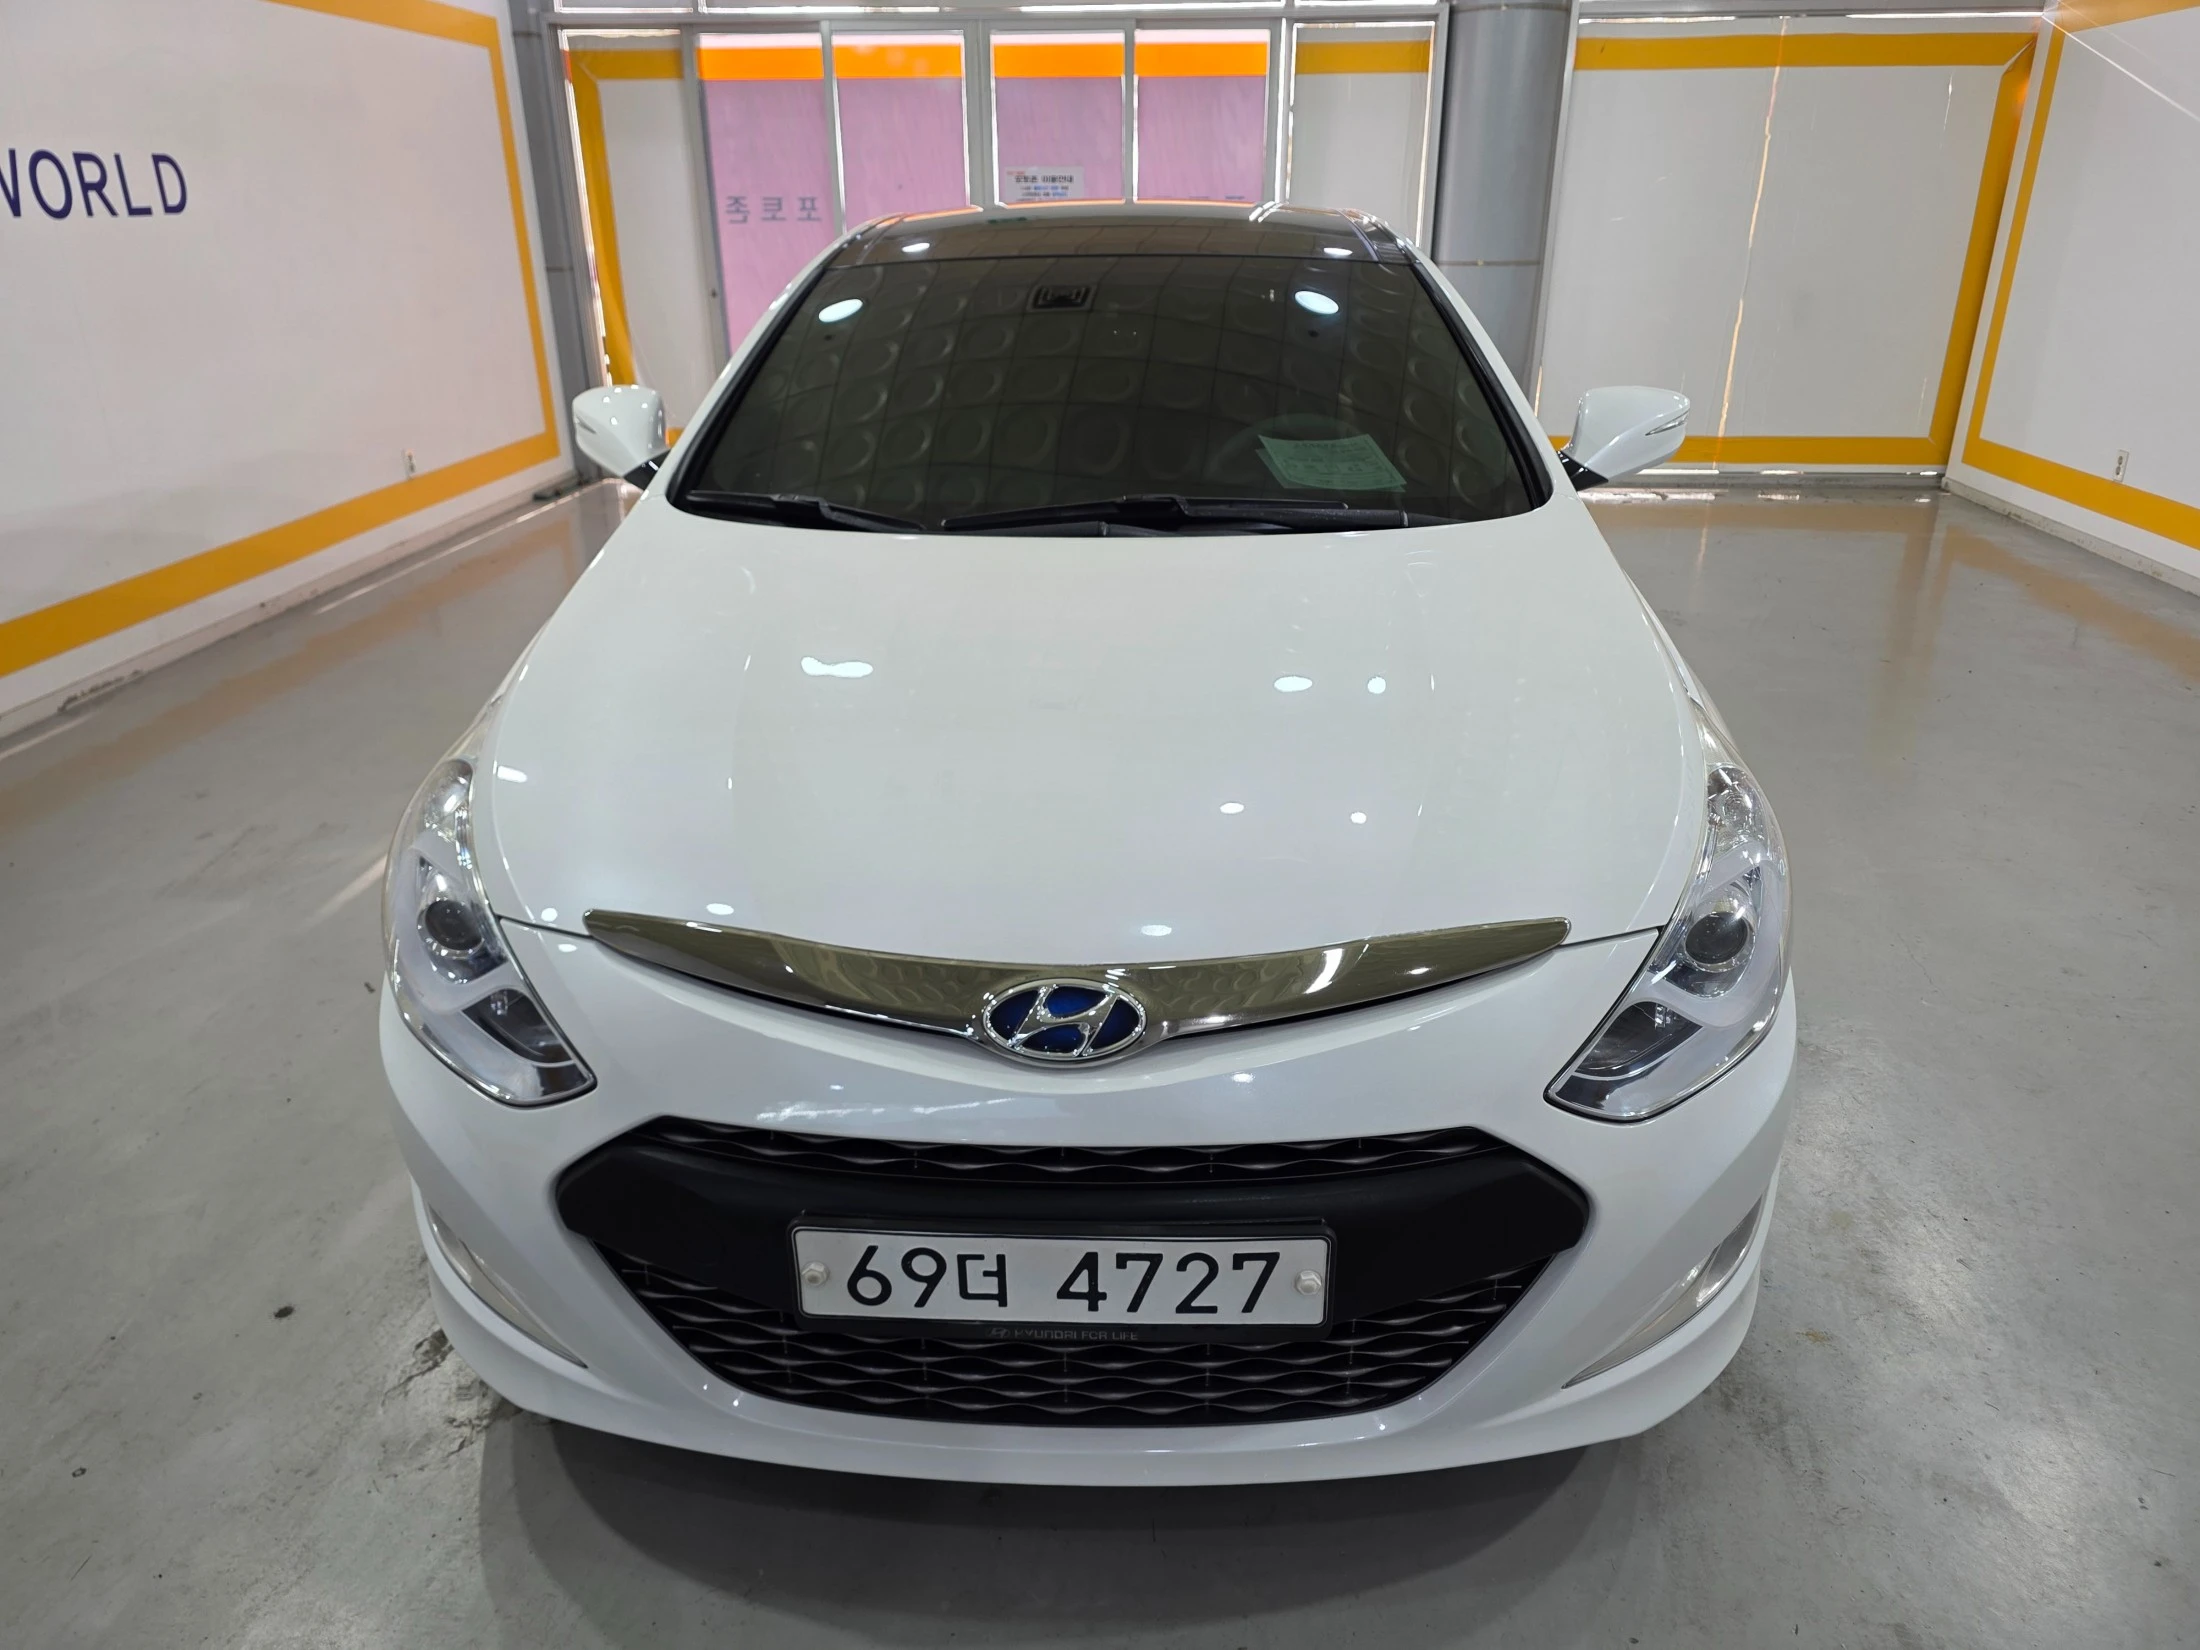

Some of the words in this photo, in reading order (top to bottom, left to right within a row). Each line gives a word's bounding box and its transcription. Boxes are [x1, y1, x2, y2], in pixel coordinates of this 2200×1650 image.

[846, 1244, 1008, 1308] 69더
[1055, 1251, 1281, 1314] 4727
[1081, 1330, 1108, 1341] FOR
[1112, 1331, 1139, 1341] LIFE
